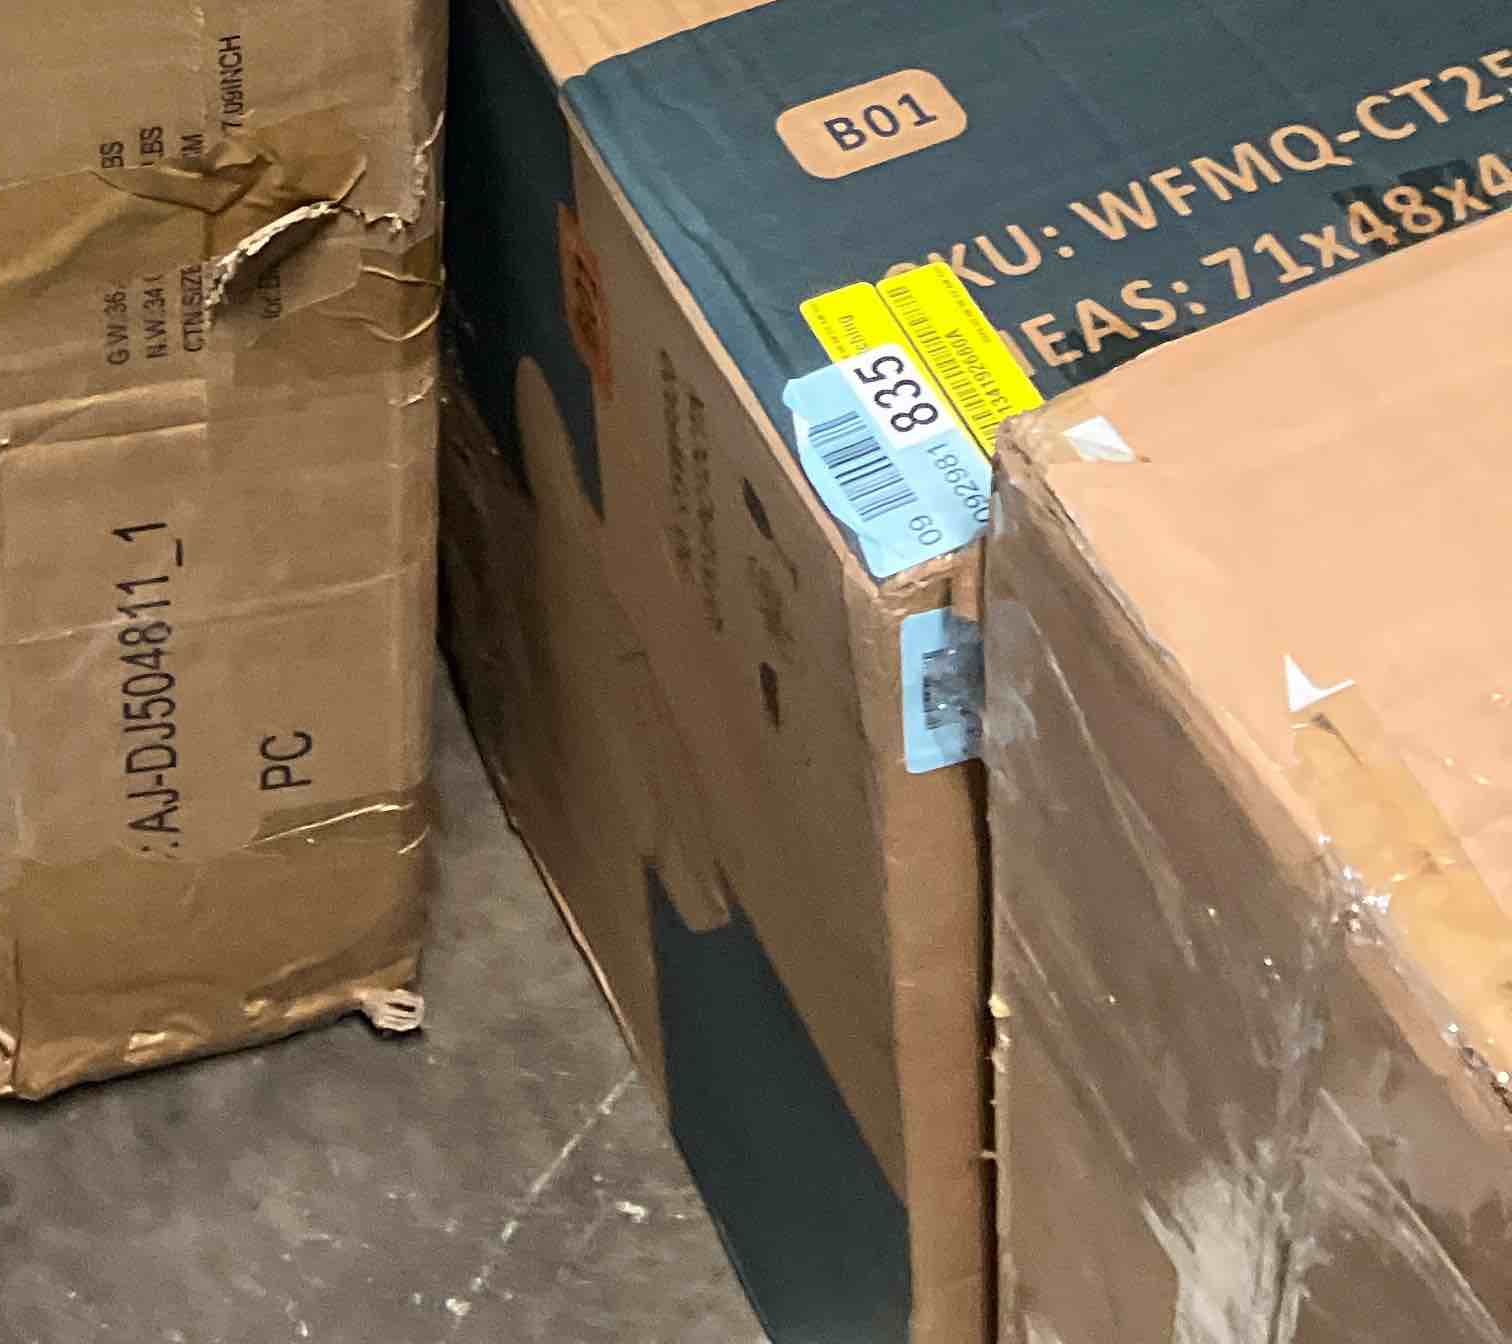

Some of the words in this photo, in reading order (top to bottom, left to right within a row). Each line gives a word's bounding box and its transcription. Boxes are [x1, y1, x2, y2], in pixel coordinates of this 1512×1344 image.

[823, 92, 940, 153] B01
[884, 224, 1077, 291] KU:
[1068, 47, 1512, 242] WFMQ-CT25
[852, 355, 939, 433] 835
[909, 514, 942, 546] 09
[258, 729, 314, 791] PC
